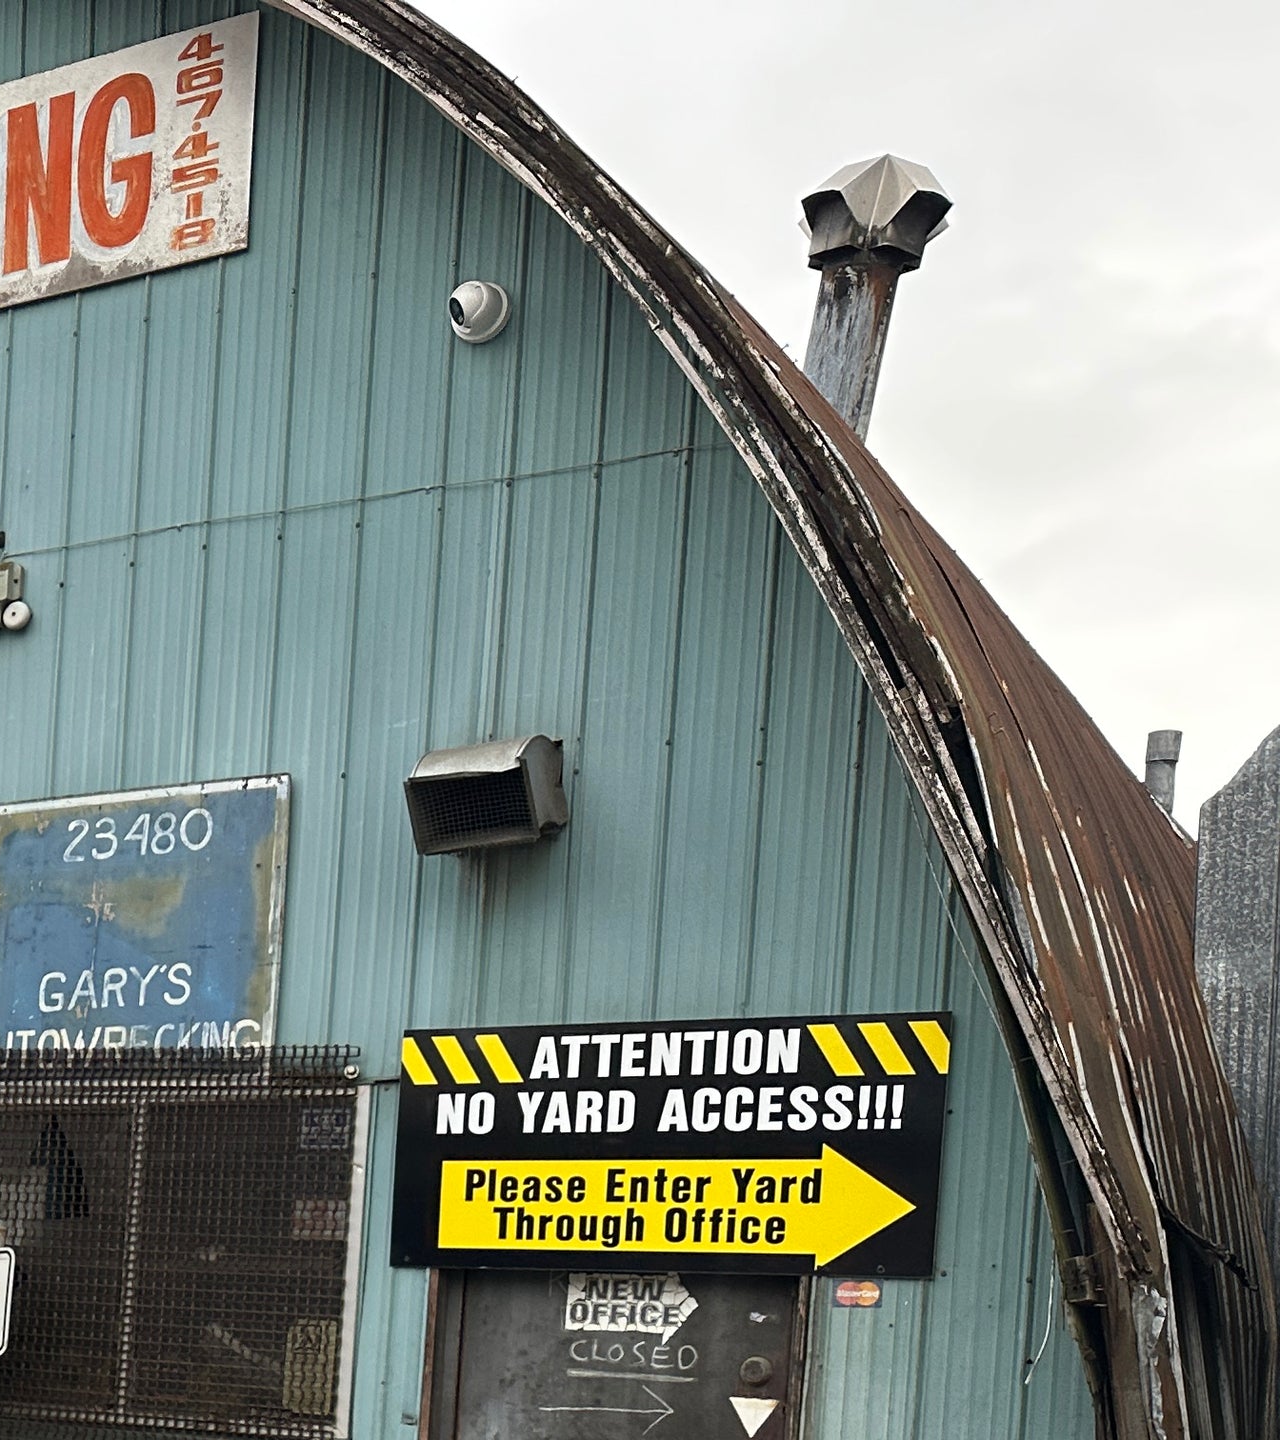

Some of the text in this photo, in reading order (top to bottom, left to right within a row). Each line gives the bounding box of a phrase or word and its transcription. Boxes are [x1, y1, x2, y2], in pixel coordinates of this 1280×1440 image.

[63, 808, 214, 863] 23480
[38, 963, 193, 1013] GARY'S
[529, 1028, 802, 1080] ATTENTION
[436, 1084, 905, 1135] NO YARD ACCESS!!!
[464, 1168, 823, 1204] Please Enter Yard
[493, 1206, 787, 1248] Through Office
[586, 1277, 665, 1301] NEW
[569, 1300, 681, 1327] OFFICE
[570, 1340, 698, 1370] CLOSED
